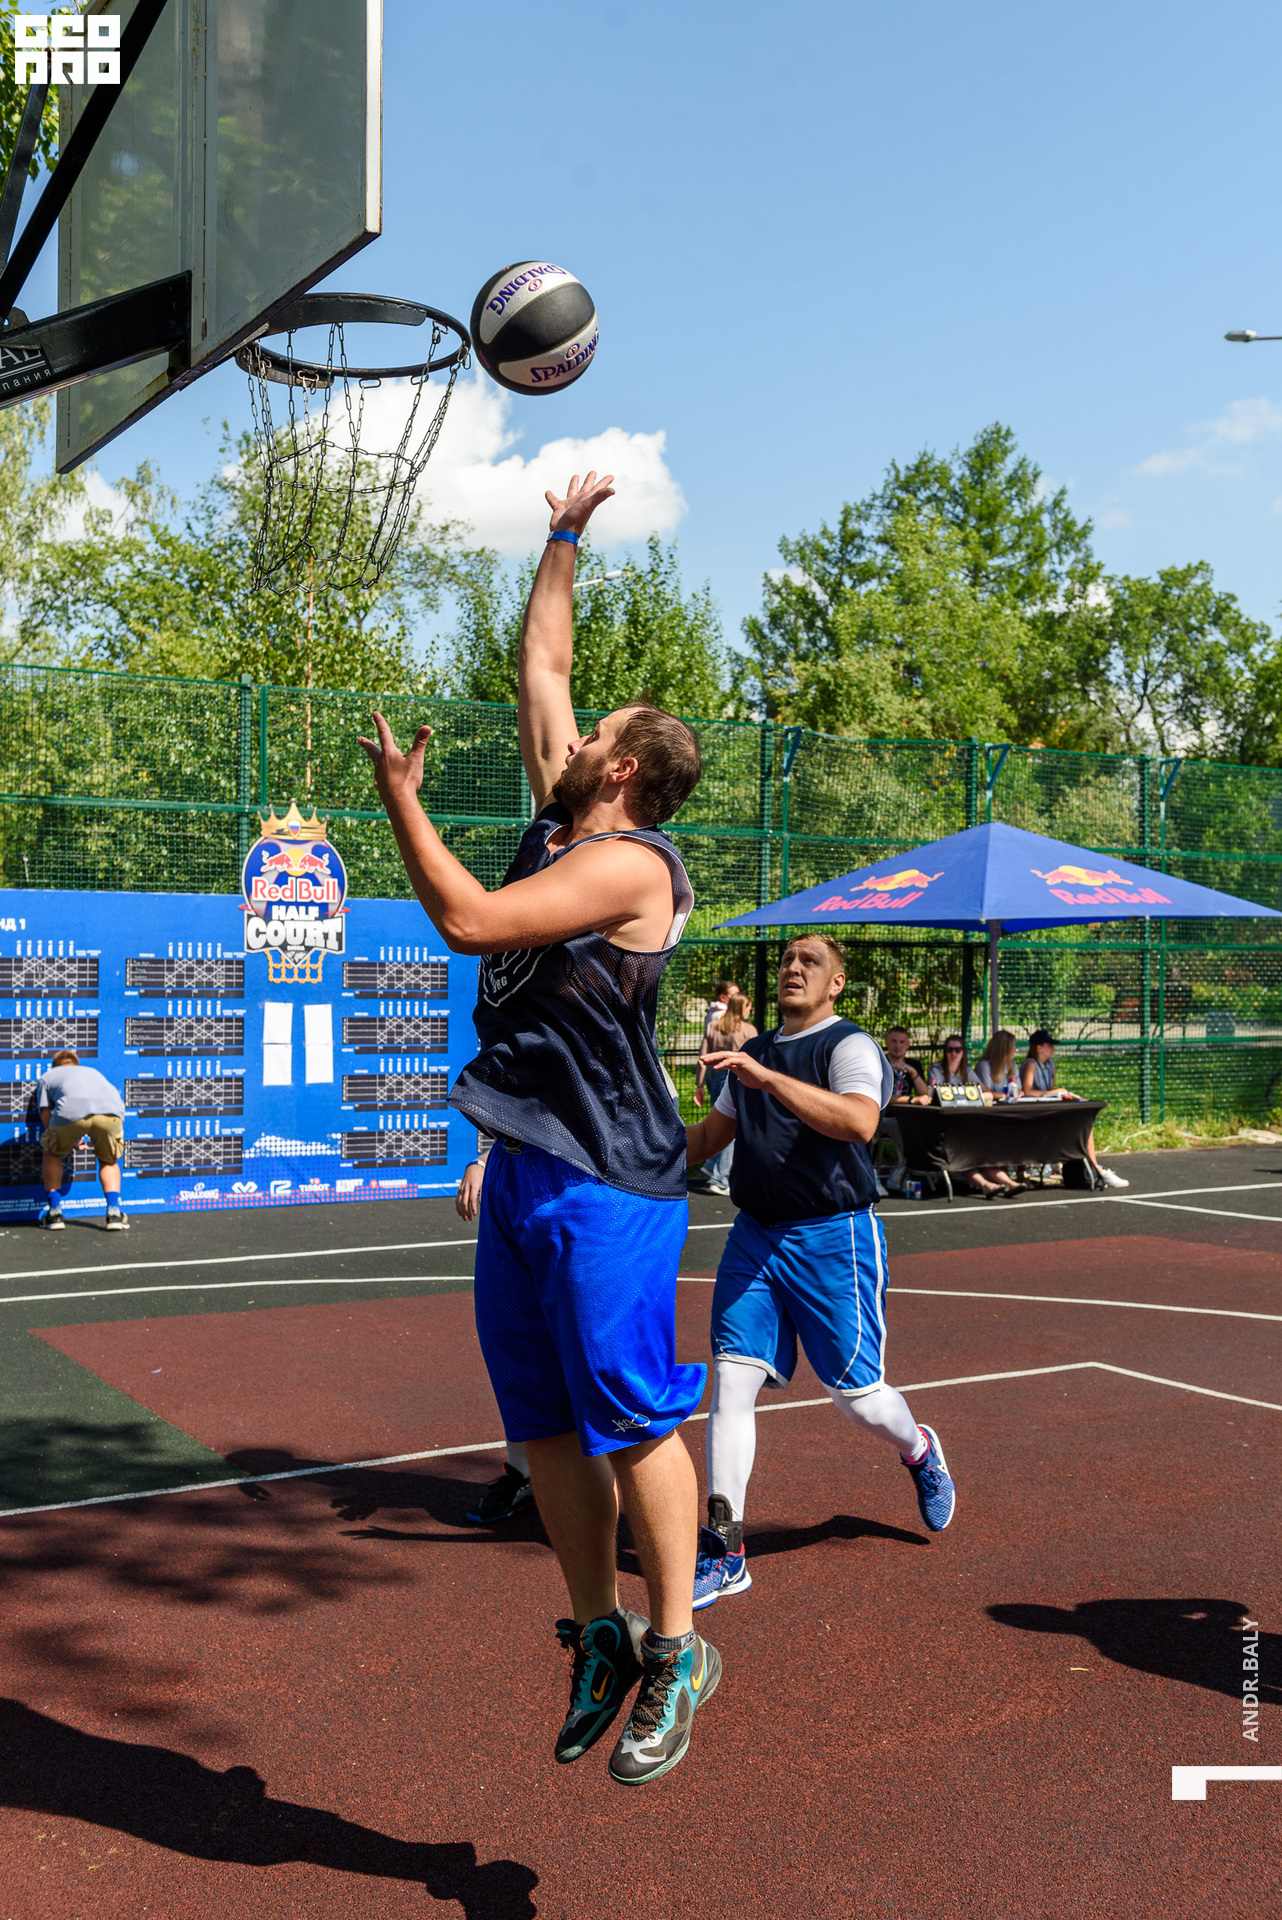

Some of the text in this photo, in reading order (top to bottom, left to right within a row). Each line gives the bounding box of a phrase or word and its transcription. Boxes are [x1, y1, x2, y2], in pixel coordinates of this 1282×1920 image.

[271, 905, 320, 921] HALF
[19, 918, 26, 930] 1
[246, 917, 344, 951] COURT
[940, 1086, 953, 1100] 3
[965, 1086, 978, 1100] 0
